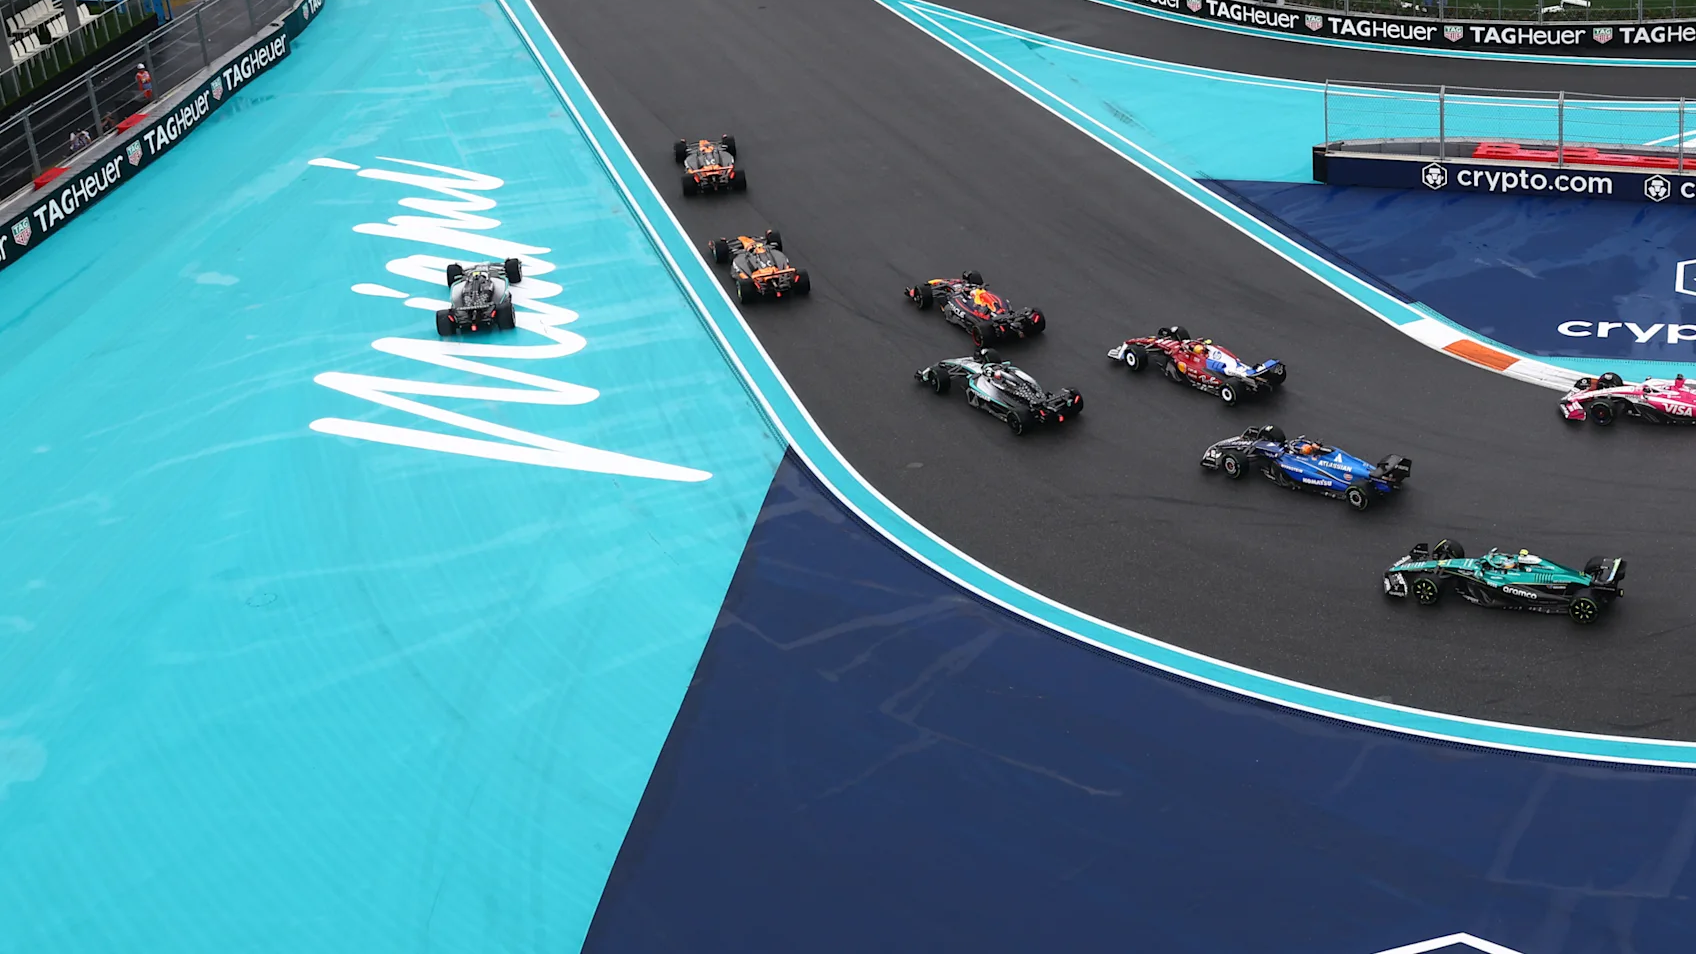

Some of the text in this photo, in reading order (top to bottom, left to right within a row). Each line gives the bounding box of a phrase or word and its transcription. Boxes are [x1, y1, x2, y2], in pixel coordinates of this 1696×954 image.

[1328, 16, 1437, 41] TAGHeuer
[1470, 25, 1586, 45] TAGHeuer
[222, 34, 288, 91] TAGHeuer
[143, 90, 211, 156] TAGHeuer
[34, 154, 124, 233] TAGHeuer
[1457, 169, 1613, 195] crypto.com
[308, 156, 713, 483] Miami
[1662, 403, 1693, 417] VISA
[1318, 460, 1352, 472] ATLASSIAN
[1502, 584, 1538, 600] aramco
